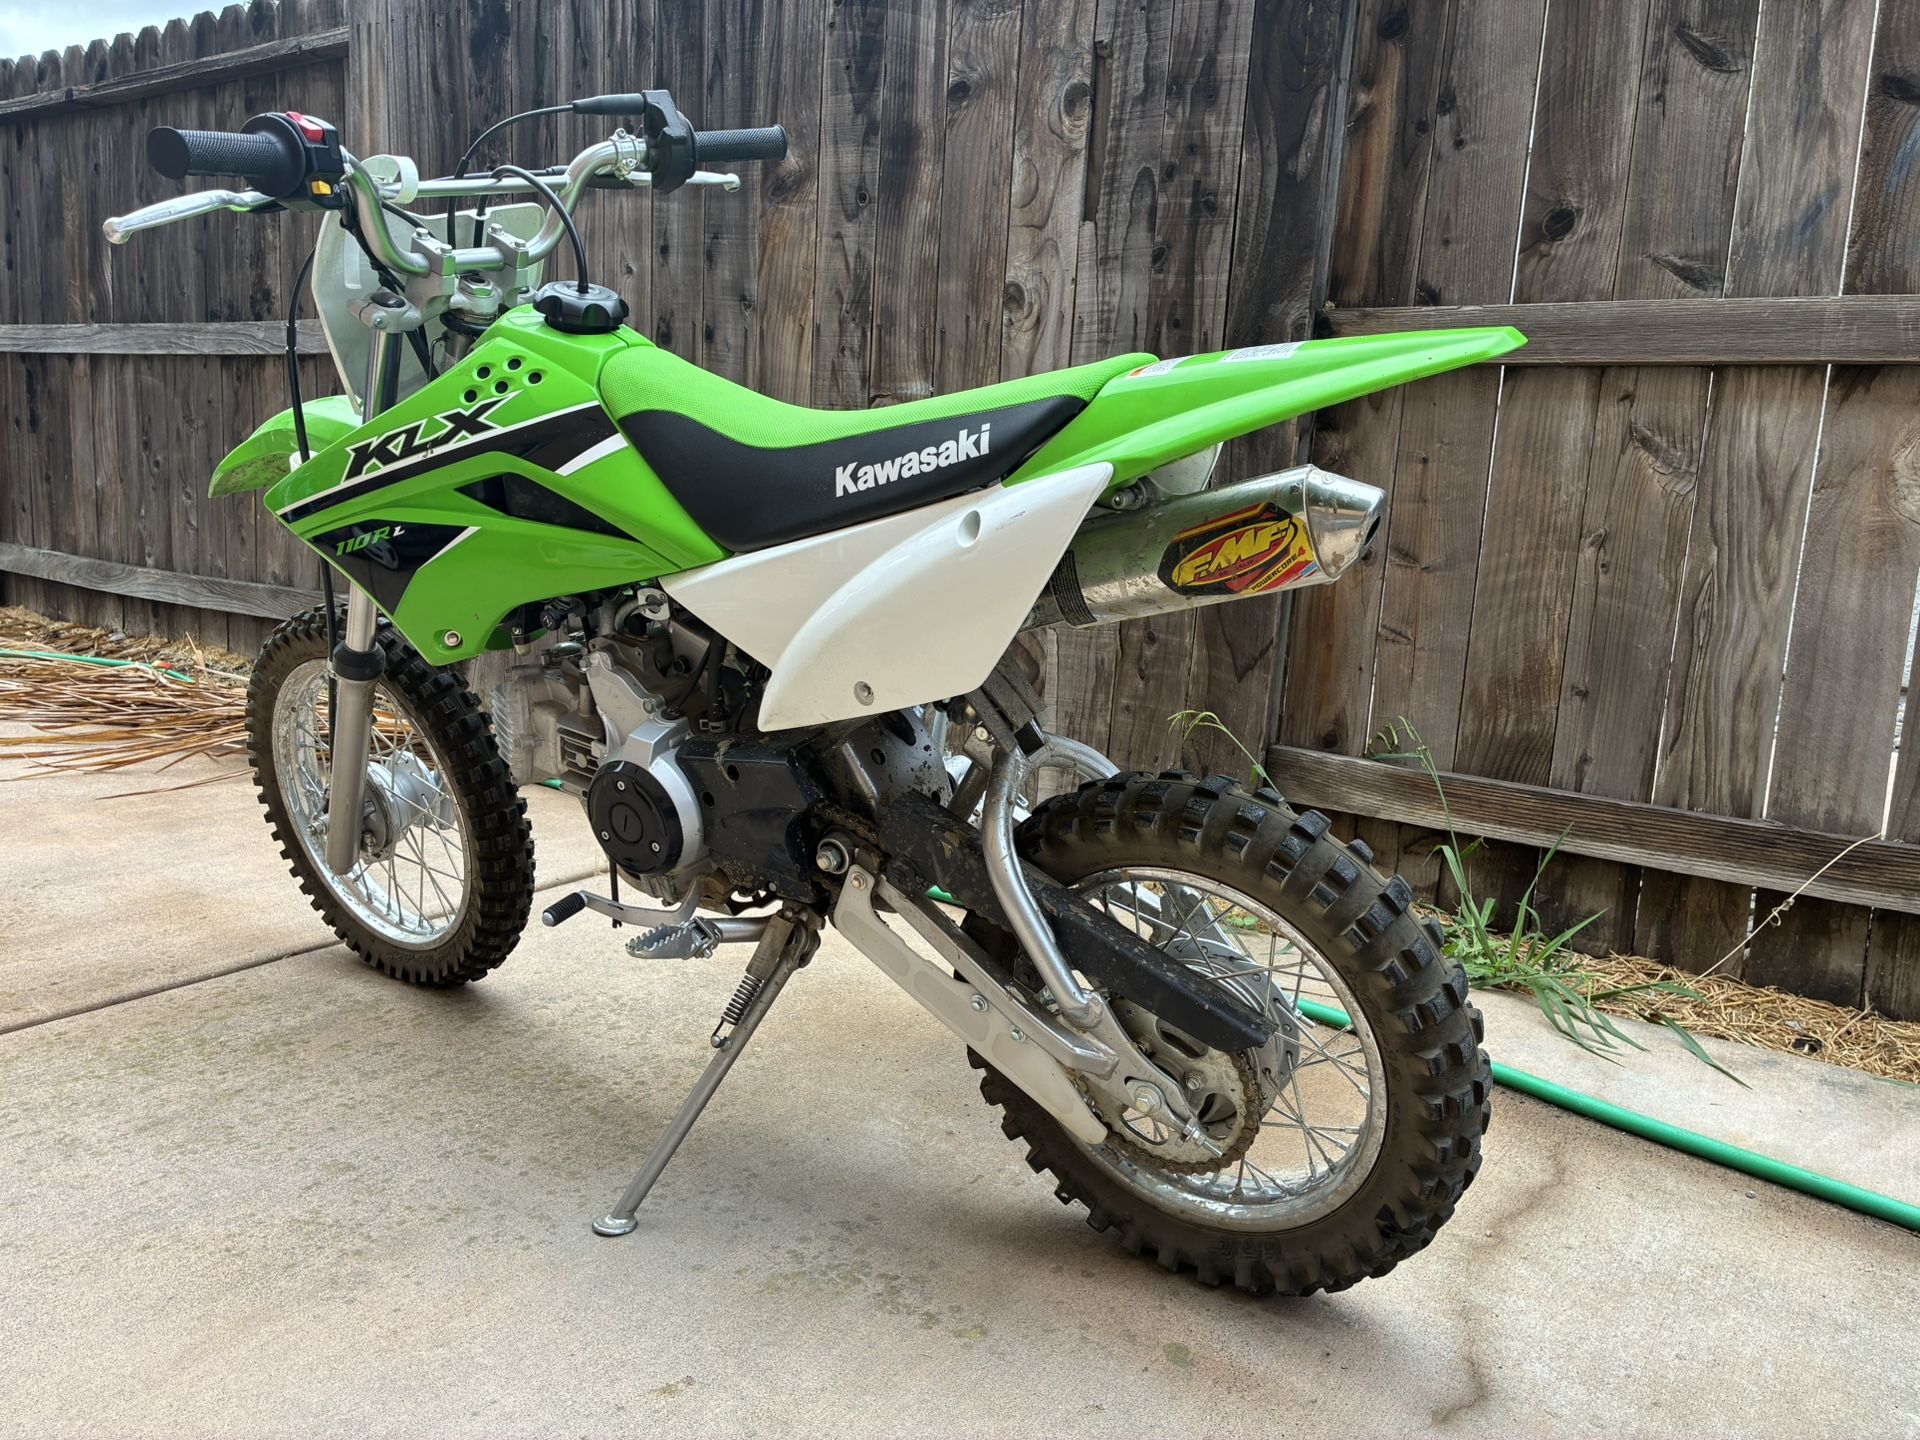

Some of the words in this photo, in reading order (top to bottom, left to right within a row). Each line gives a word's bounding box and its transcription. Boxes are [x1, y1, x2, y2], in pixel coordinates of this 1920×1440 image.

[341, 394, 508, 484] KLX
[835, 423, 991, 498] Kawasaki
[1177, 518, 1291, 587] FMF
[1251, 553, 1298, 591] POWERCORE
